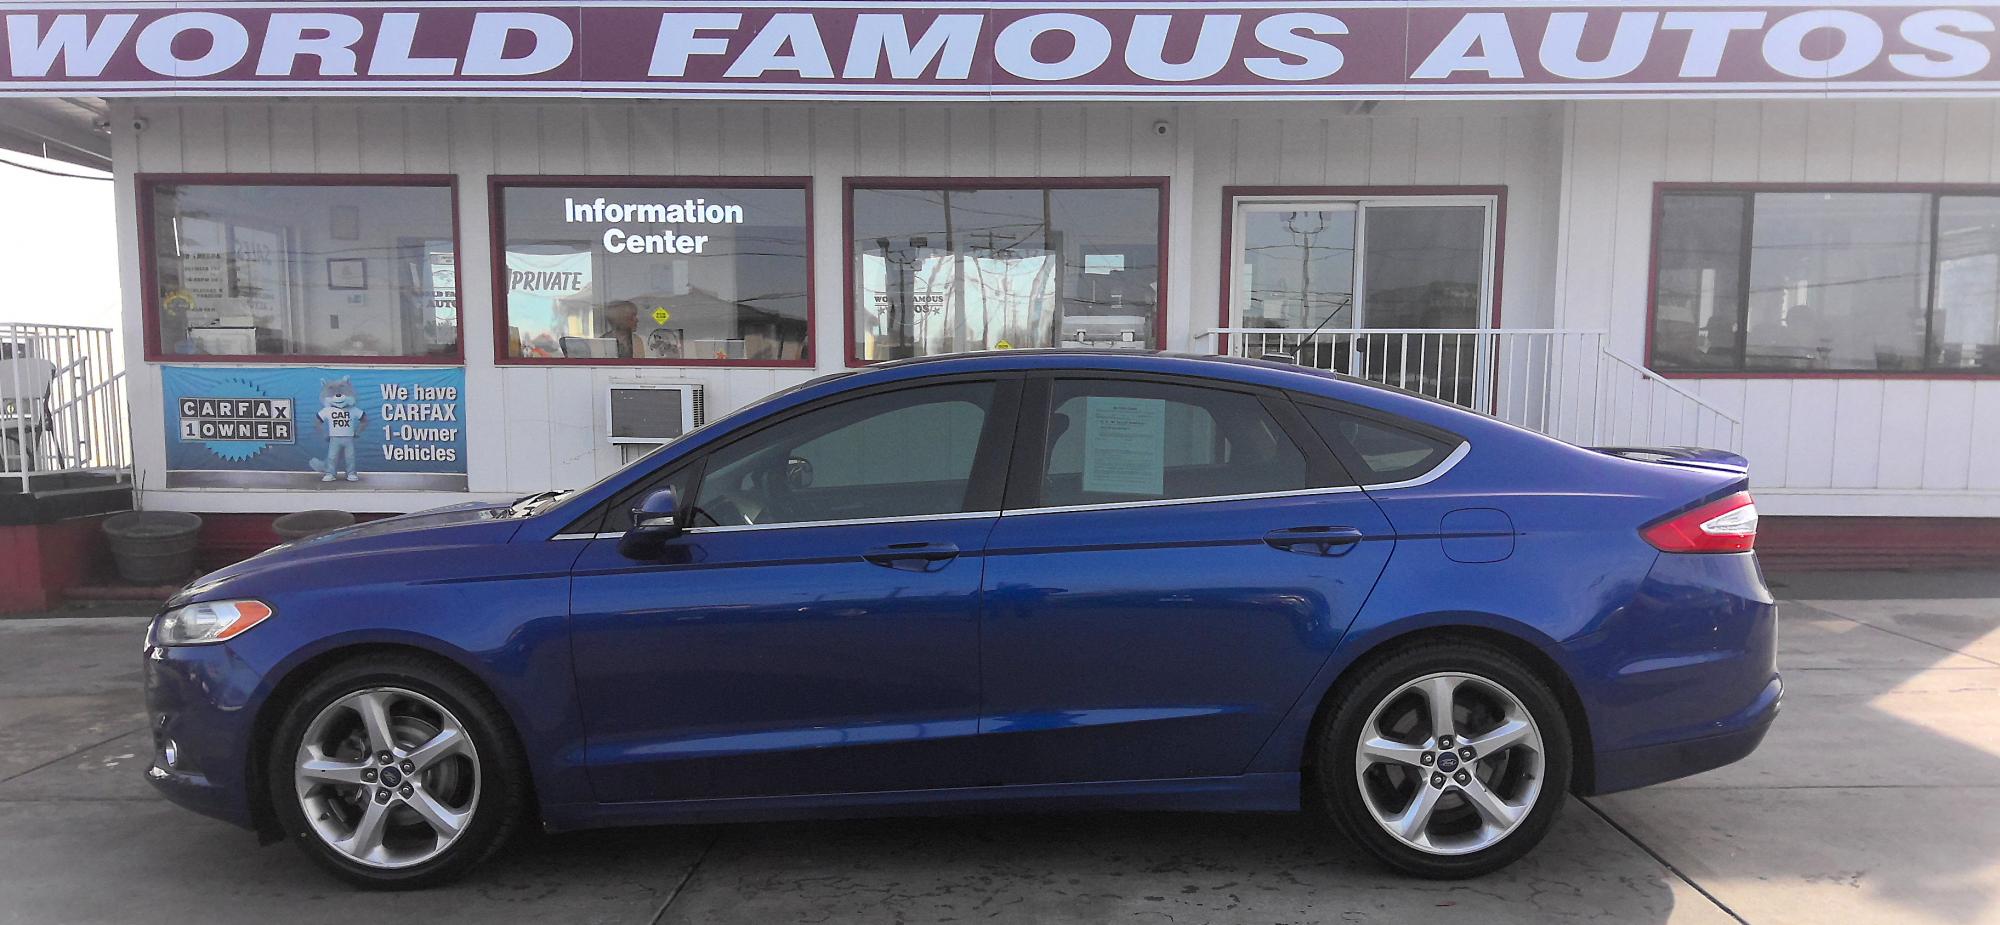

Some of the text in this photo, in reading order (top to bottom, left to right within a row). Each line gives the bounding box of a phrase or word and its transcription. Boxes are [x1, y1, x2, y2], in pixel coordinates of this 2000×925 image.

[5, 9, 1997, 81] WORLD FAMOUS AUTOS
[565, 198, 744, 224] Information
[603, 228, 709, 254] Center
[511, 270, 583, 291] PRIVATE
[380, 383, 458, 401] We have
[183, 401, 287, 419] CARFAX
[331, 411, 351, 420] CAR
[381, 403, 457, 421] CARFAX
[185, 423, 288, 438] 1 OWNER
[333, 420, 351, 428] FOX
[382, 424, 458, 442] 1-Owner
[382, 444, 456, 462] Vehicles
